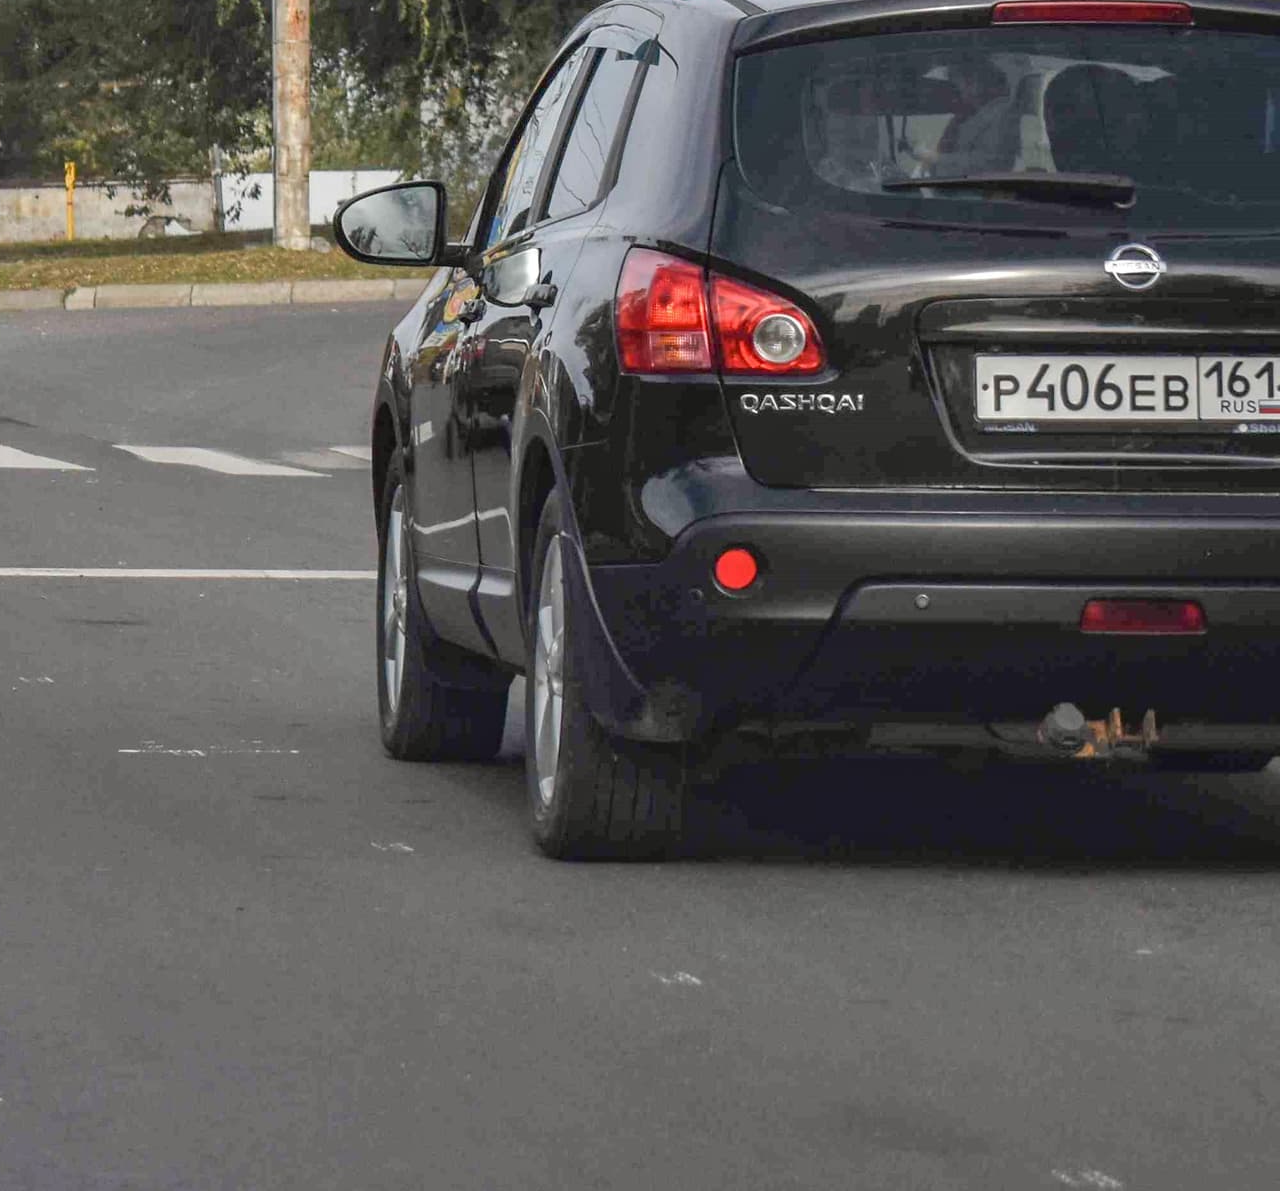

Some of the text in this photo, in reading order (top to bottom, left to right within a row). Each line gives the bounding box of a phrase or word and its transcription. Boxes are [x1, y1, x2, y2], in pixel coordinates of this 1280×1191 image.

[993, 361, 1276, 413] Р406ЕВ 161
[740, 393, 864, 414] QASHQAI
[1220, 400, 1257, 414] RUS
